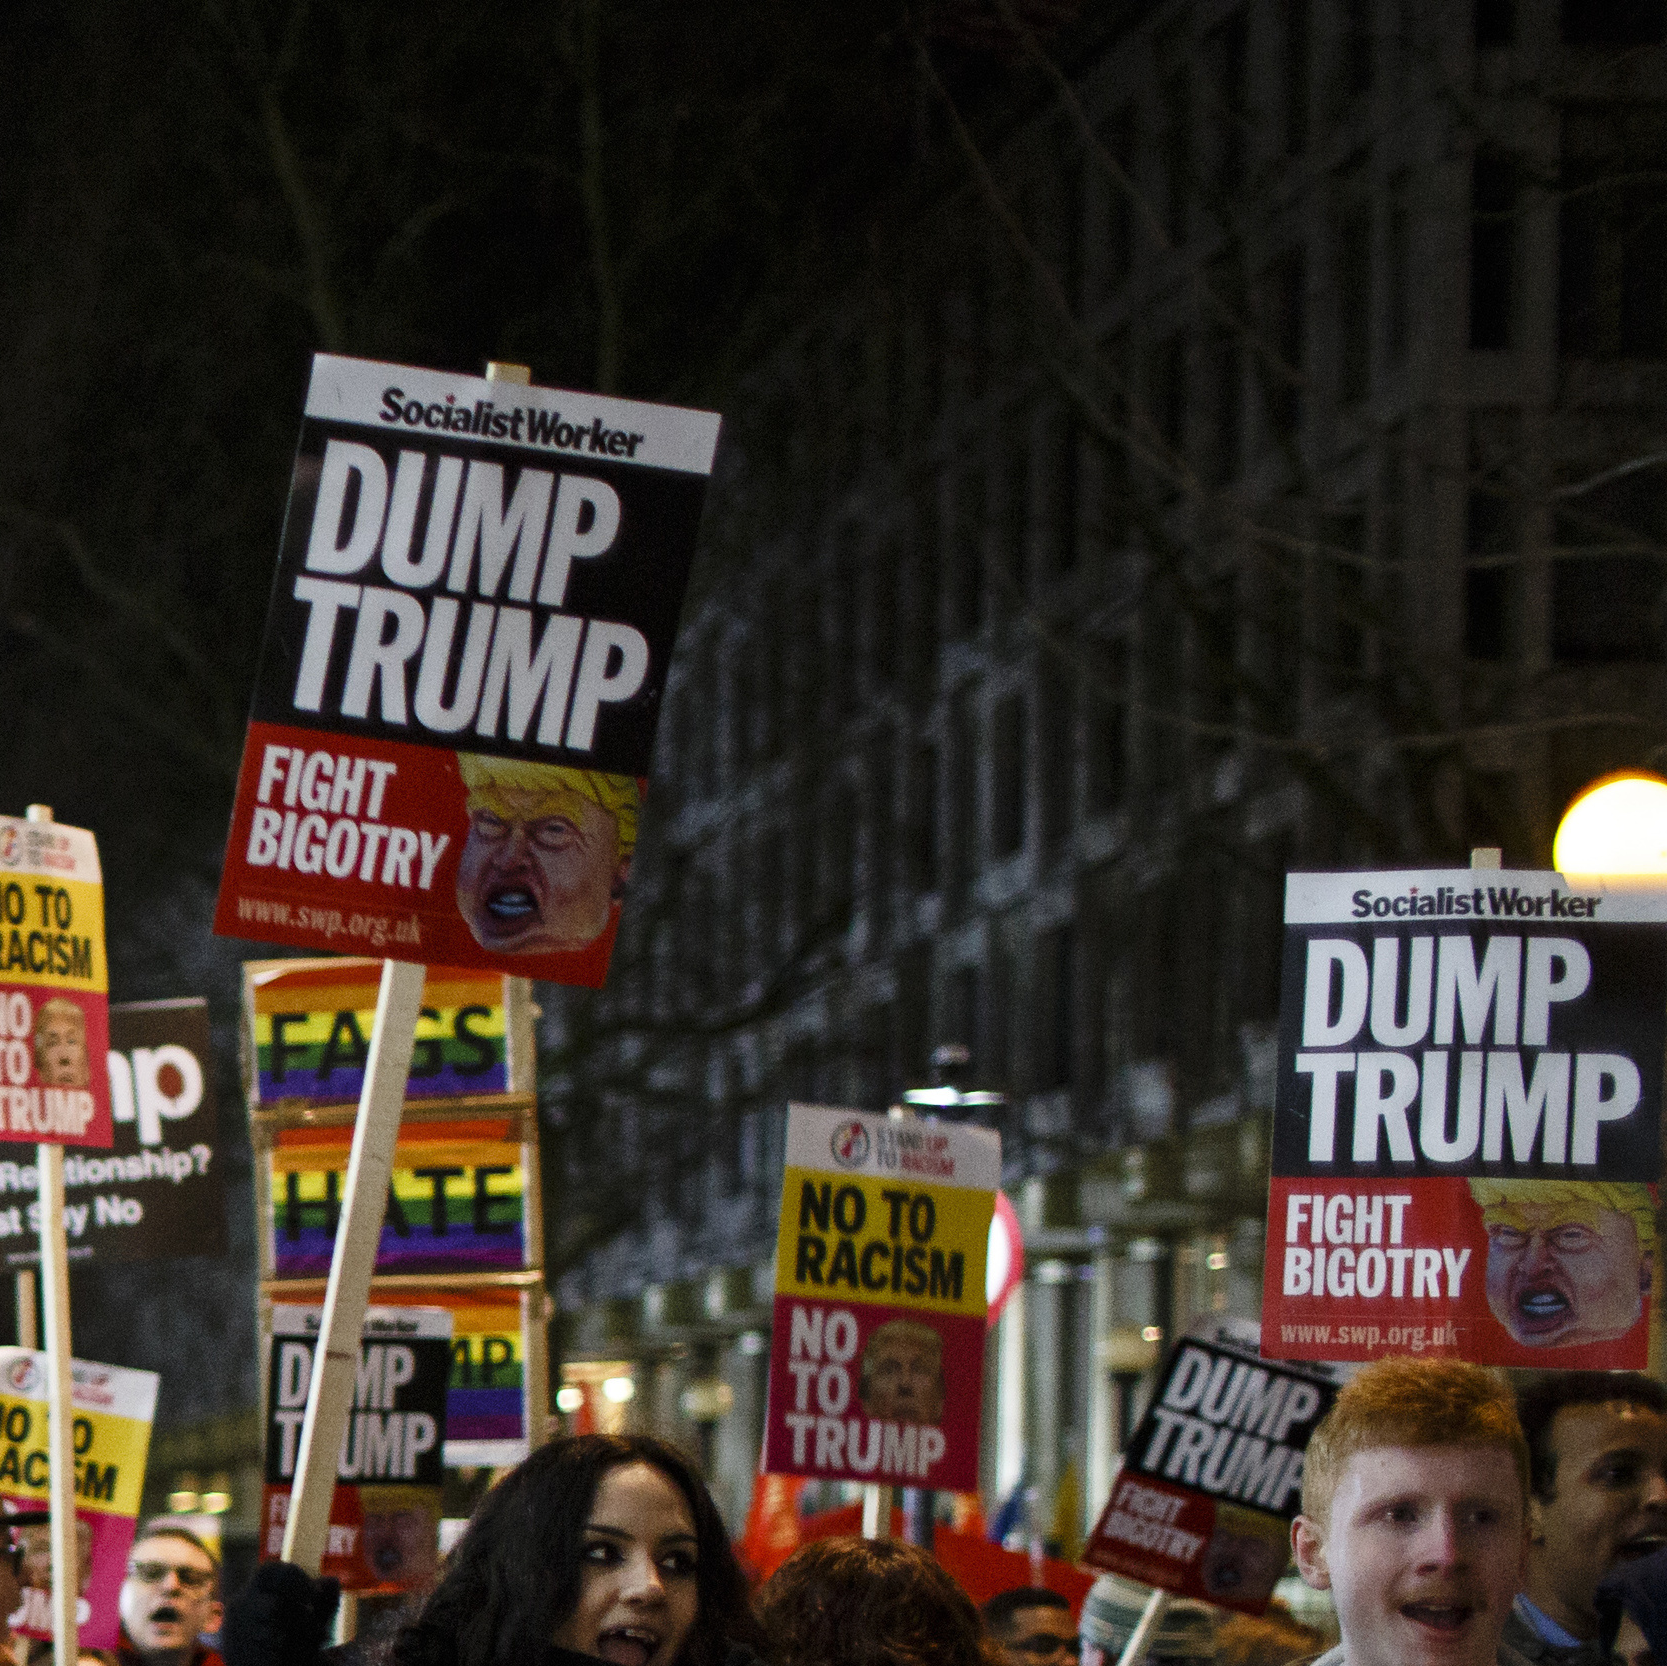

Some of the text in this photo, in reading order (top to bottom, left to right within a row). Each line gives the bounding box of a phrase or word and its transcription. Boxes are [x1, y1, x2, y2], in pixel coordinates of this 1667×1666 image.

[305, 439, 621, 607] DUMP
[293, 576, 649, 752] TRUMP
[257, 744, 397, 820] FIGHT
[246, 808, 450, 891] BIGOTRY
[37, 886, 72, 928] TO
[238, 897, 421, 946] www.swp.org.uk
[1302, 936, 1591, 1047] DUMP
[1295, 1051, 1641, 1166] TRUMP
[95, 1195, 144, 1226] No
[799, 1180, 935, 1243] NO TO
[1285, 1194, 1412, 1246] FIGHT
[795, 1235, 964, 1301] RACISM
[1283, 1247, 1472, 1299] BIGOTRY
[790, 1305, 858, 1363] NO
[1280, 1322, 1457, 1352] www.swp.org.uk
[278, 1343, 415, 1409] DMP
[788, 1358, 850, 1416] TO
[1164, 1347, 1319, 1441] DUMP
[274, 1411, 436, 1478] TUMP
[785, 1413, 945, 1477] TRUMP
